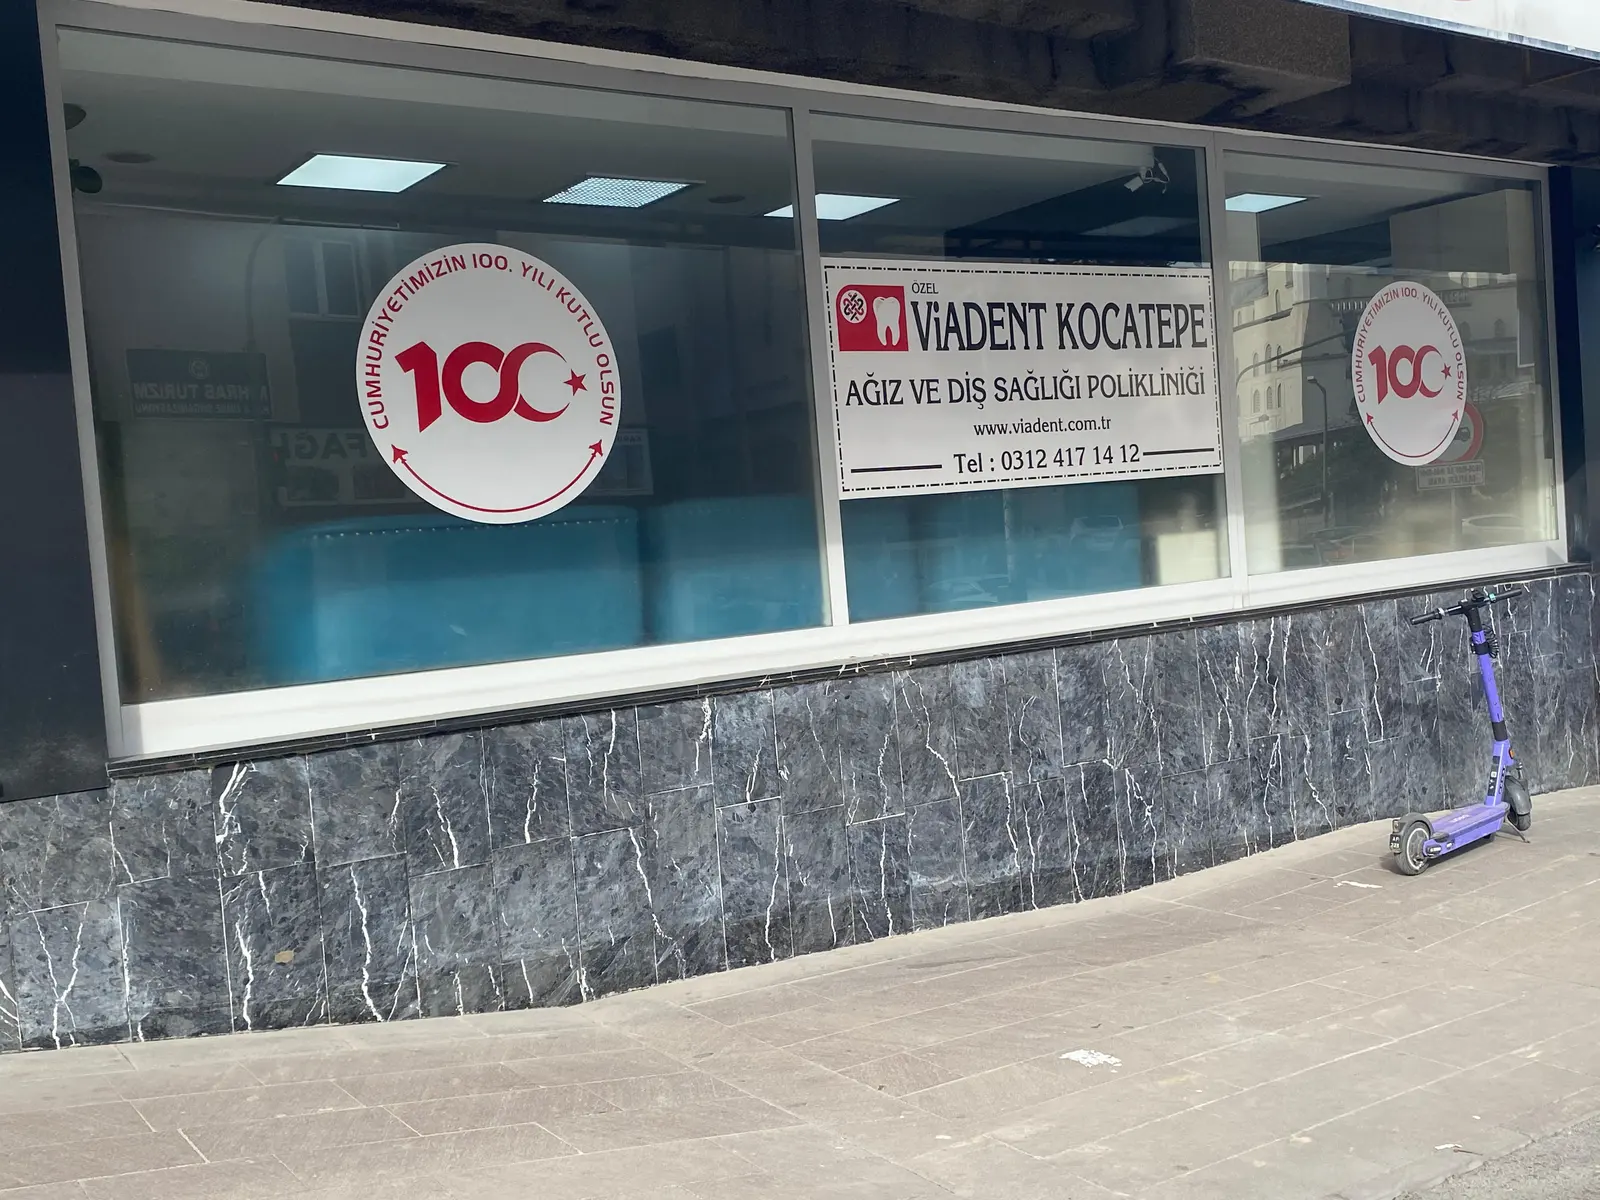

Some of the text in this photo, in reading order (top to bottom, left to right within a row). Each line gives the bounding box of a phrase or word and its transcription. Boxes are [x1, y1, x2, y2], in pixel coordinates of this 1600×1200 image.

[911, 280, 939, 295] ÖZEL
[365, 253, 466, 430] CUMHURİYETİMİZİN
[521, 261, 556, 291] YILI
[555, 286, 604, 348] KUTLU
[596, 353, 615, 426] OLSUN
[1055, 301, 1208, 351] KOCATEPE
[1355, 287, 1400, 403] CUMHURİYETİMİZİN
[1422, 291, 1438, 312] YILI
[1437, 307, 1460, 349] KUTLU
[1455, 351, 1464, 401] OLSUN
[845, 366, 1206, 410] AĞIZ VE DİŞ SAĞLIĞI POLİKLİNİĞİ
[973, 415, 1112, 436] www.viadent.com.tr
[953, 452, 984, 474] Tel
[1001, 448, 1048, 471] 0312
[1053, 446, 1086, 468] 417
[1092, 445, 1114, 465] 14
[1119, 443, 1140, 463] 12
